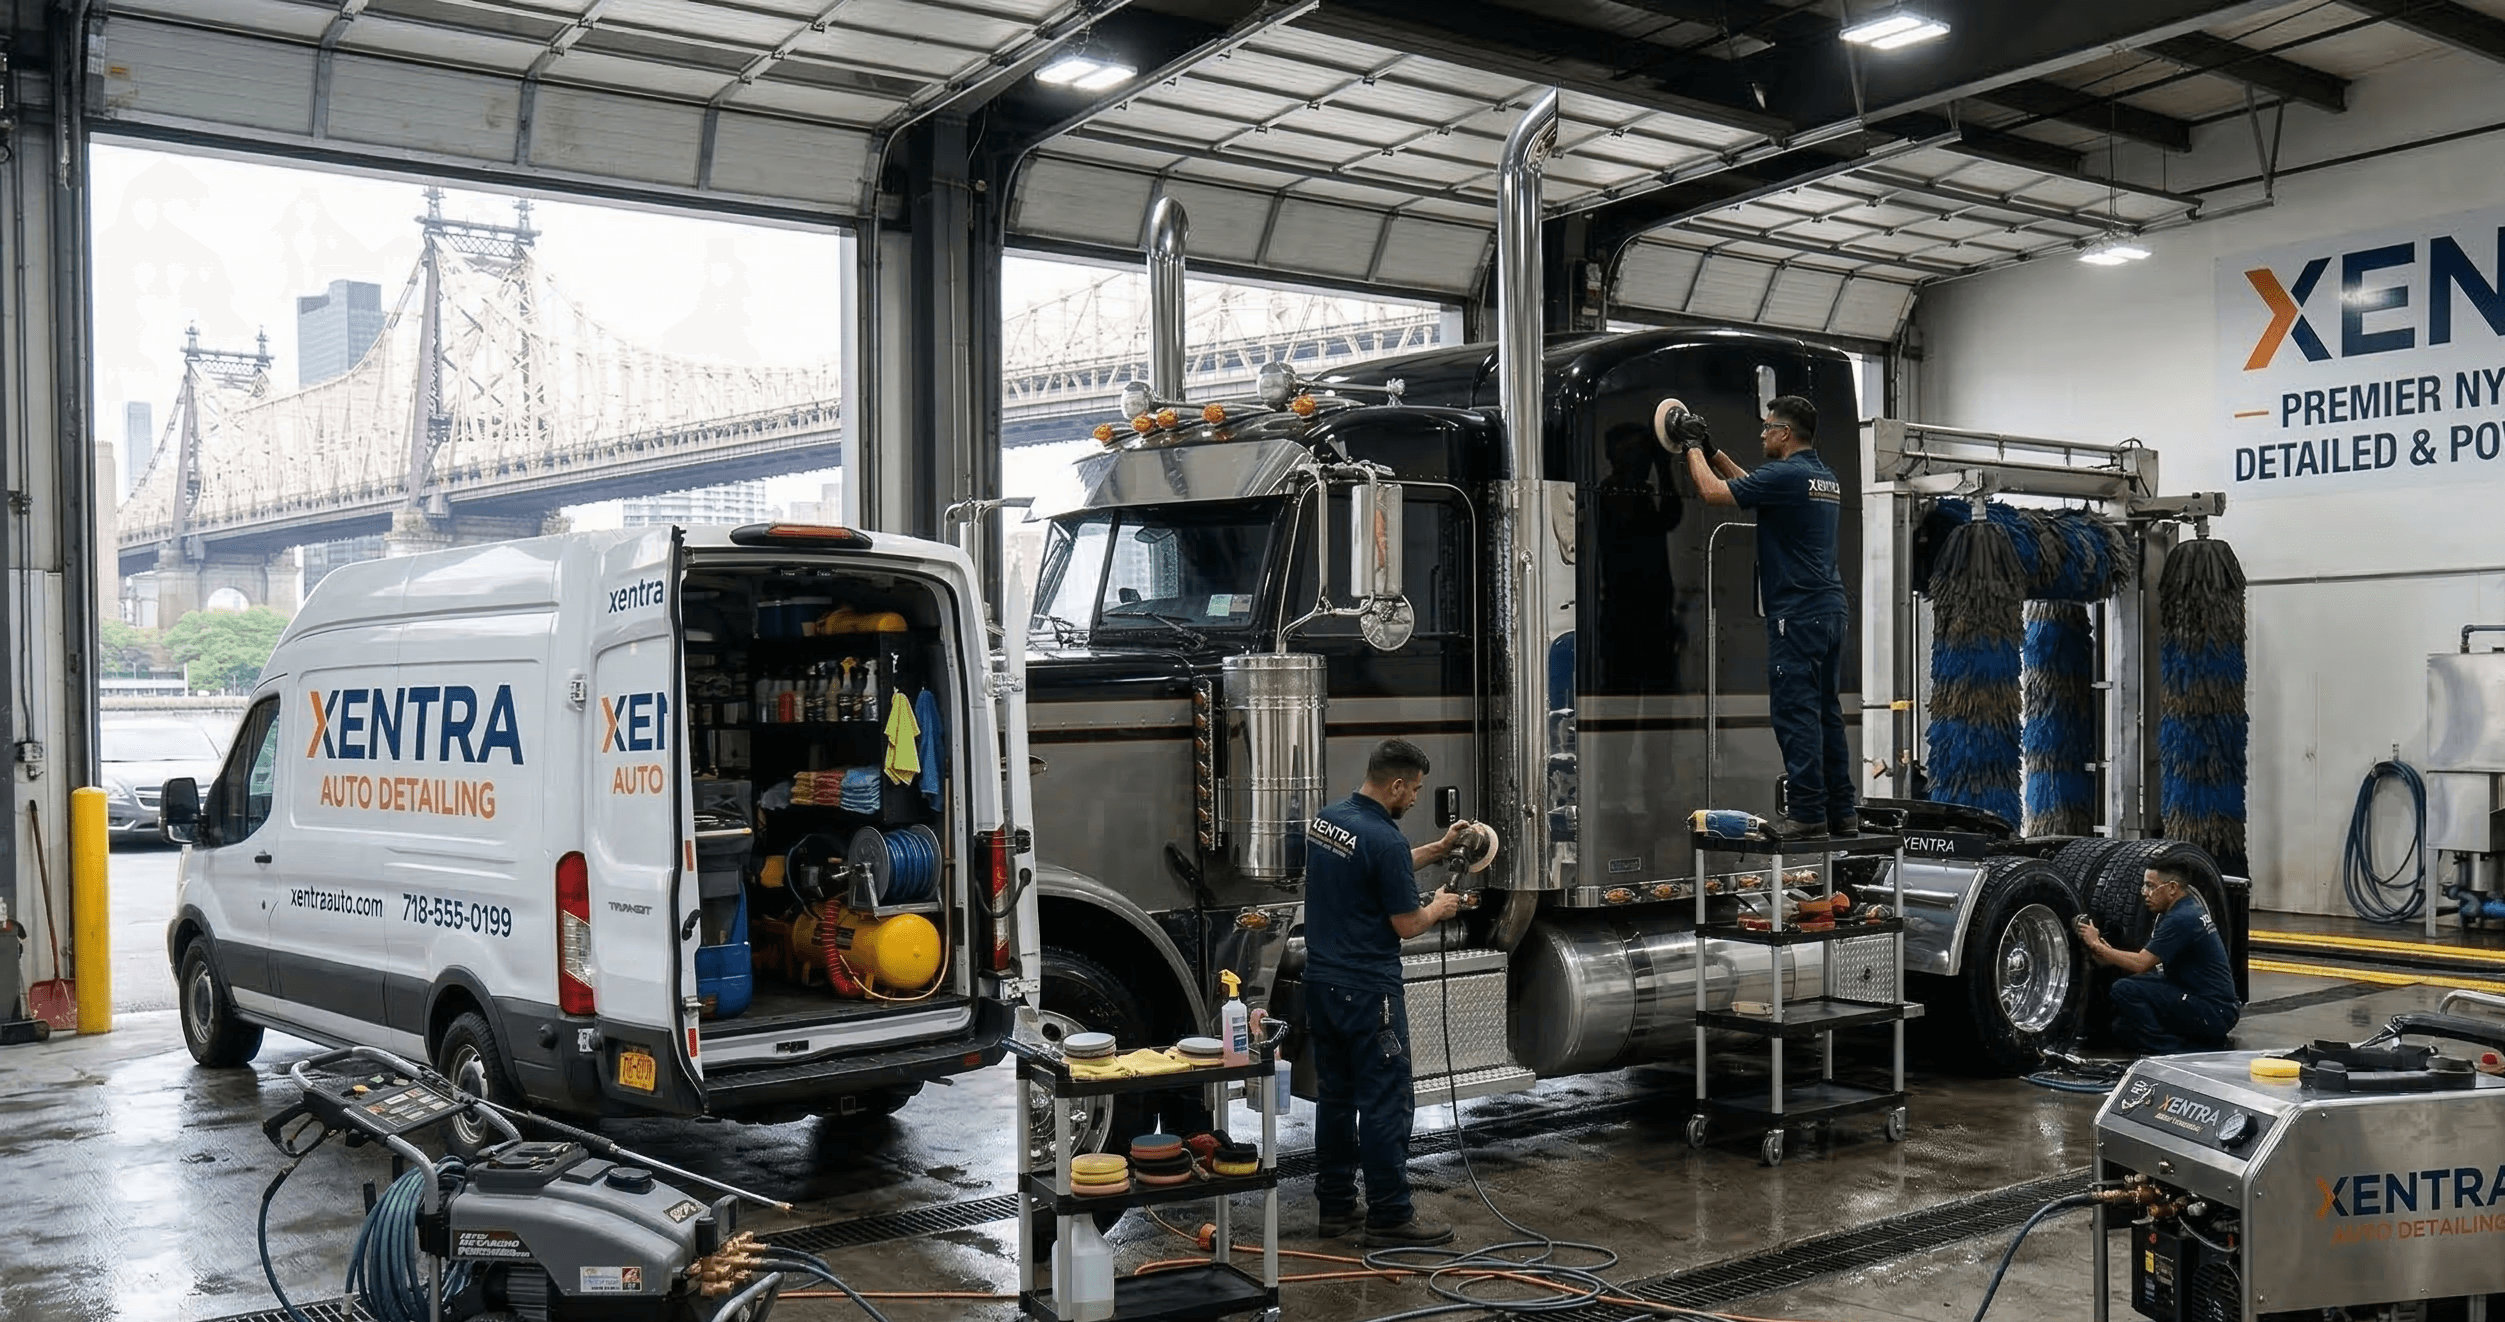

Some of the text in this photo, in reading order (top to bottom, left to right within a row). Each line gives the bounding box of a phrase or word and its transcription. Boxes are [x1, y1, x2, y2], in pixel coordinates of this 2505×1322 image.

[2282, 367, 2505, 428] PREMIER NY
[2236, 421, 2505, 482] DETAILED & PO
[608, 579, 664, 613] xentra
[306, 684, 524, 765] XENTRA
[320, 775, 495, 819] AUTO DETAILING
[613, 765, 664, 794] AUTO
[291, 886, 512, 938] xentraauto.com 718-555-0199
[2158, 1094, 2220, 1127] XENTRA
